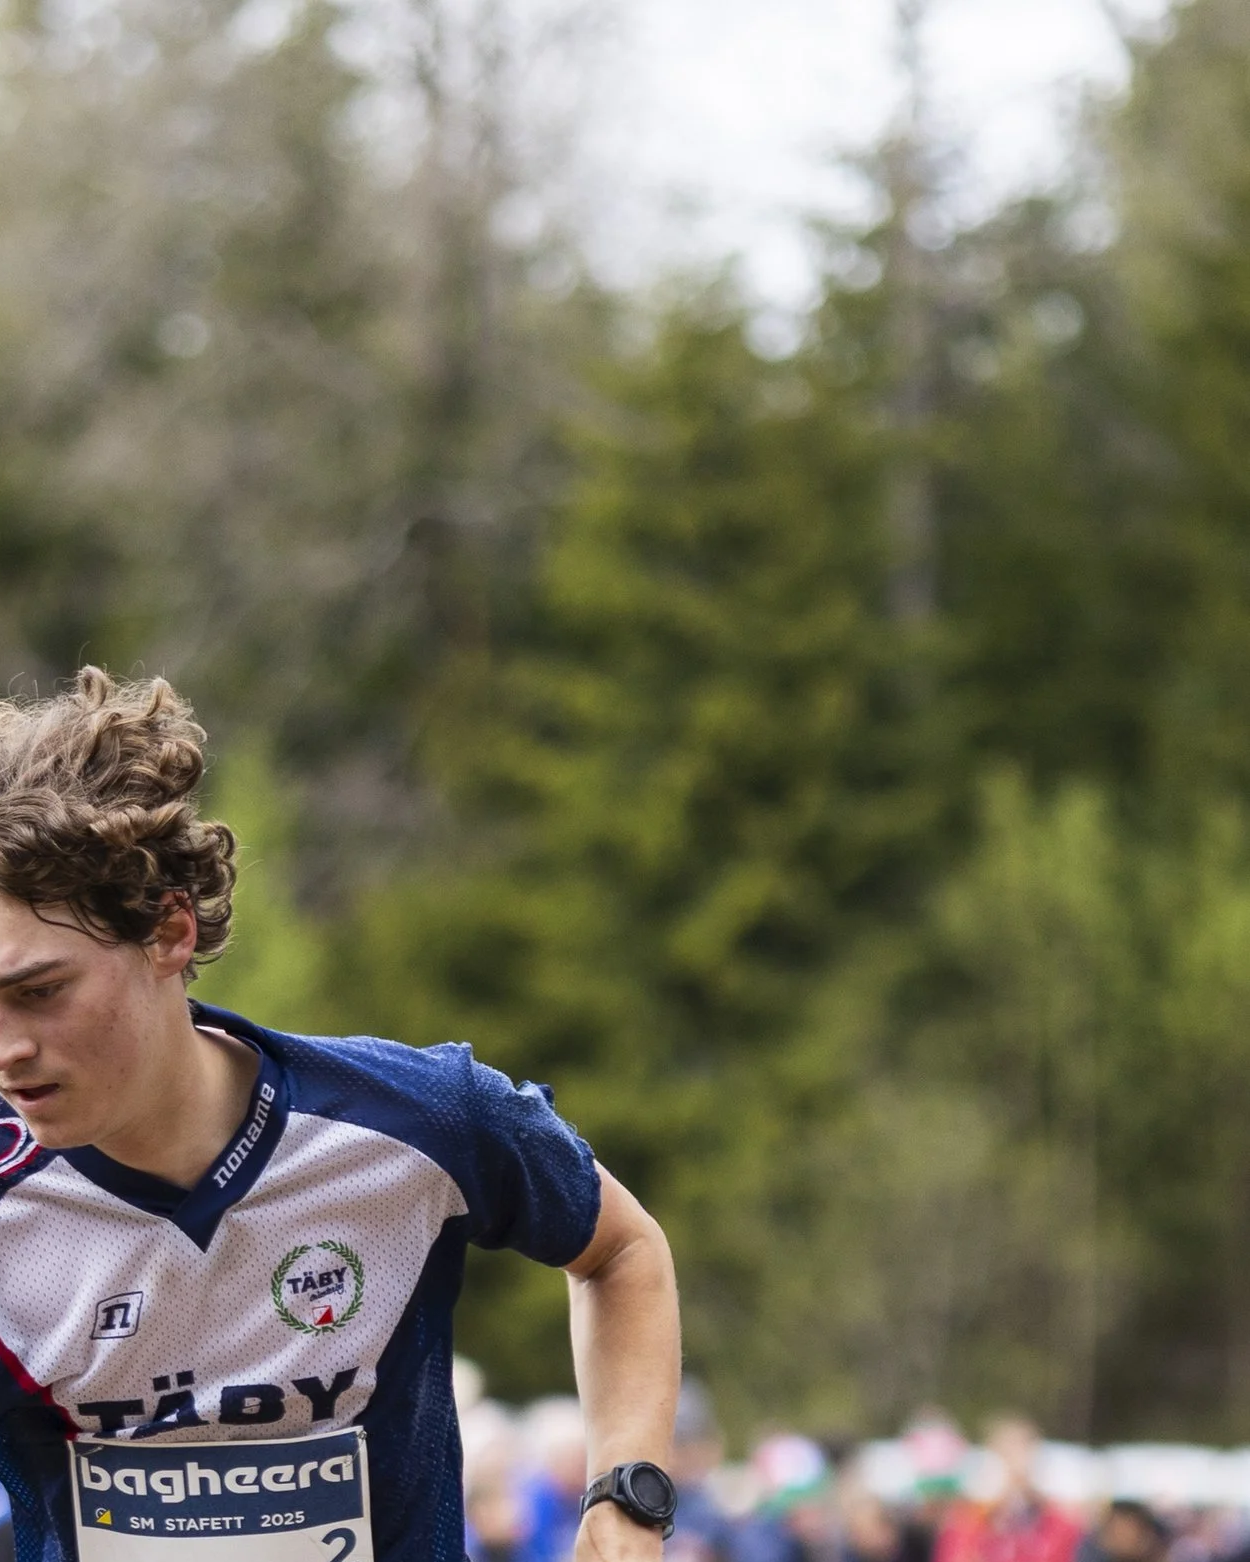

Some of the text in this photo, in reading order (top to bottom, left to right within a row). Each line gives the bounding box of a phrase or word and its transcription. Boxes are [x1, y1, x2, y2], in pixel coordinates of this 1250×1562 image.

[213, 1083, 276, 1189] noname
[287, 1266, 348, 1295] TÄBY
[77, 1366, 360, 1440] TÄBY
[80, 1453, 355, 1504] bagheera
[129, 1510, 306, 1532] SM STAFETT 2025
